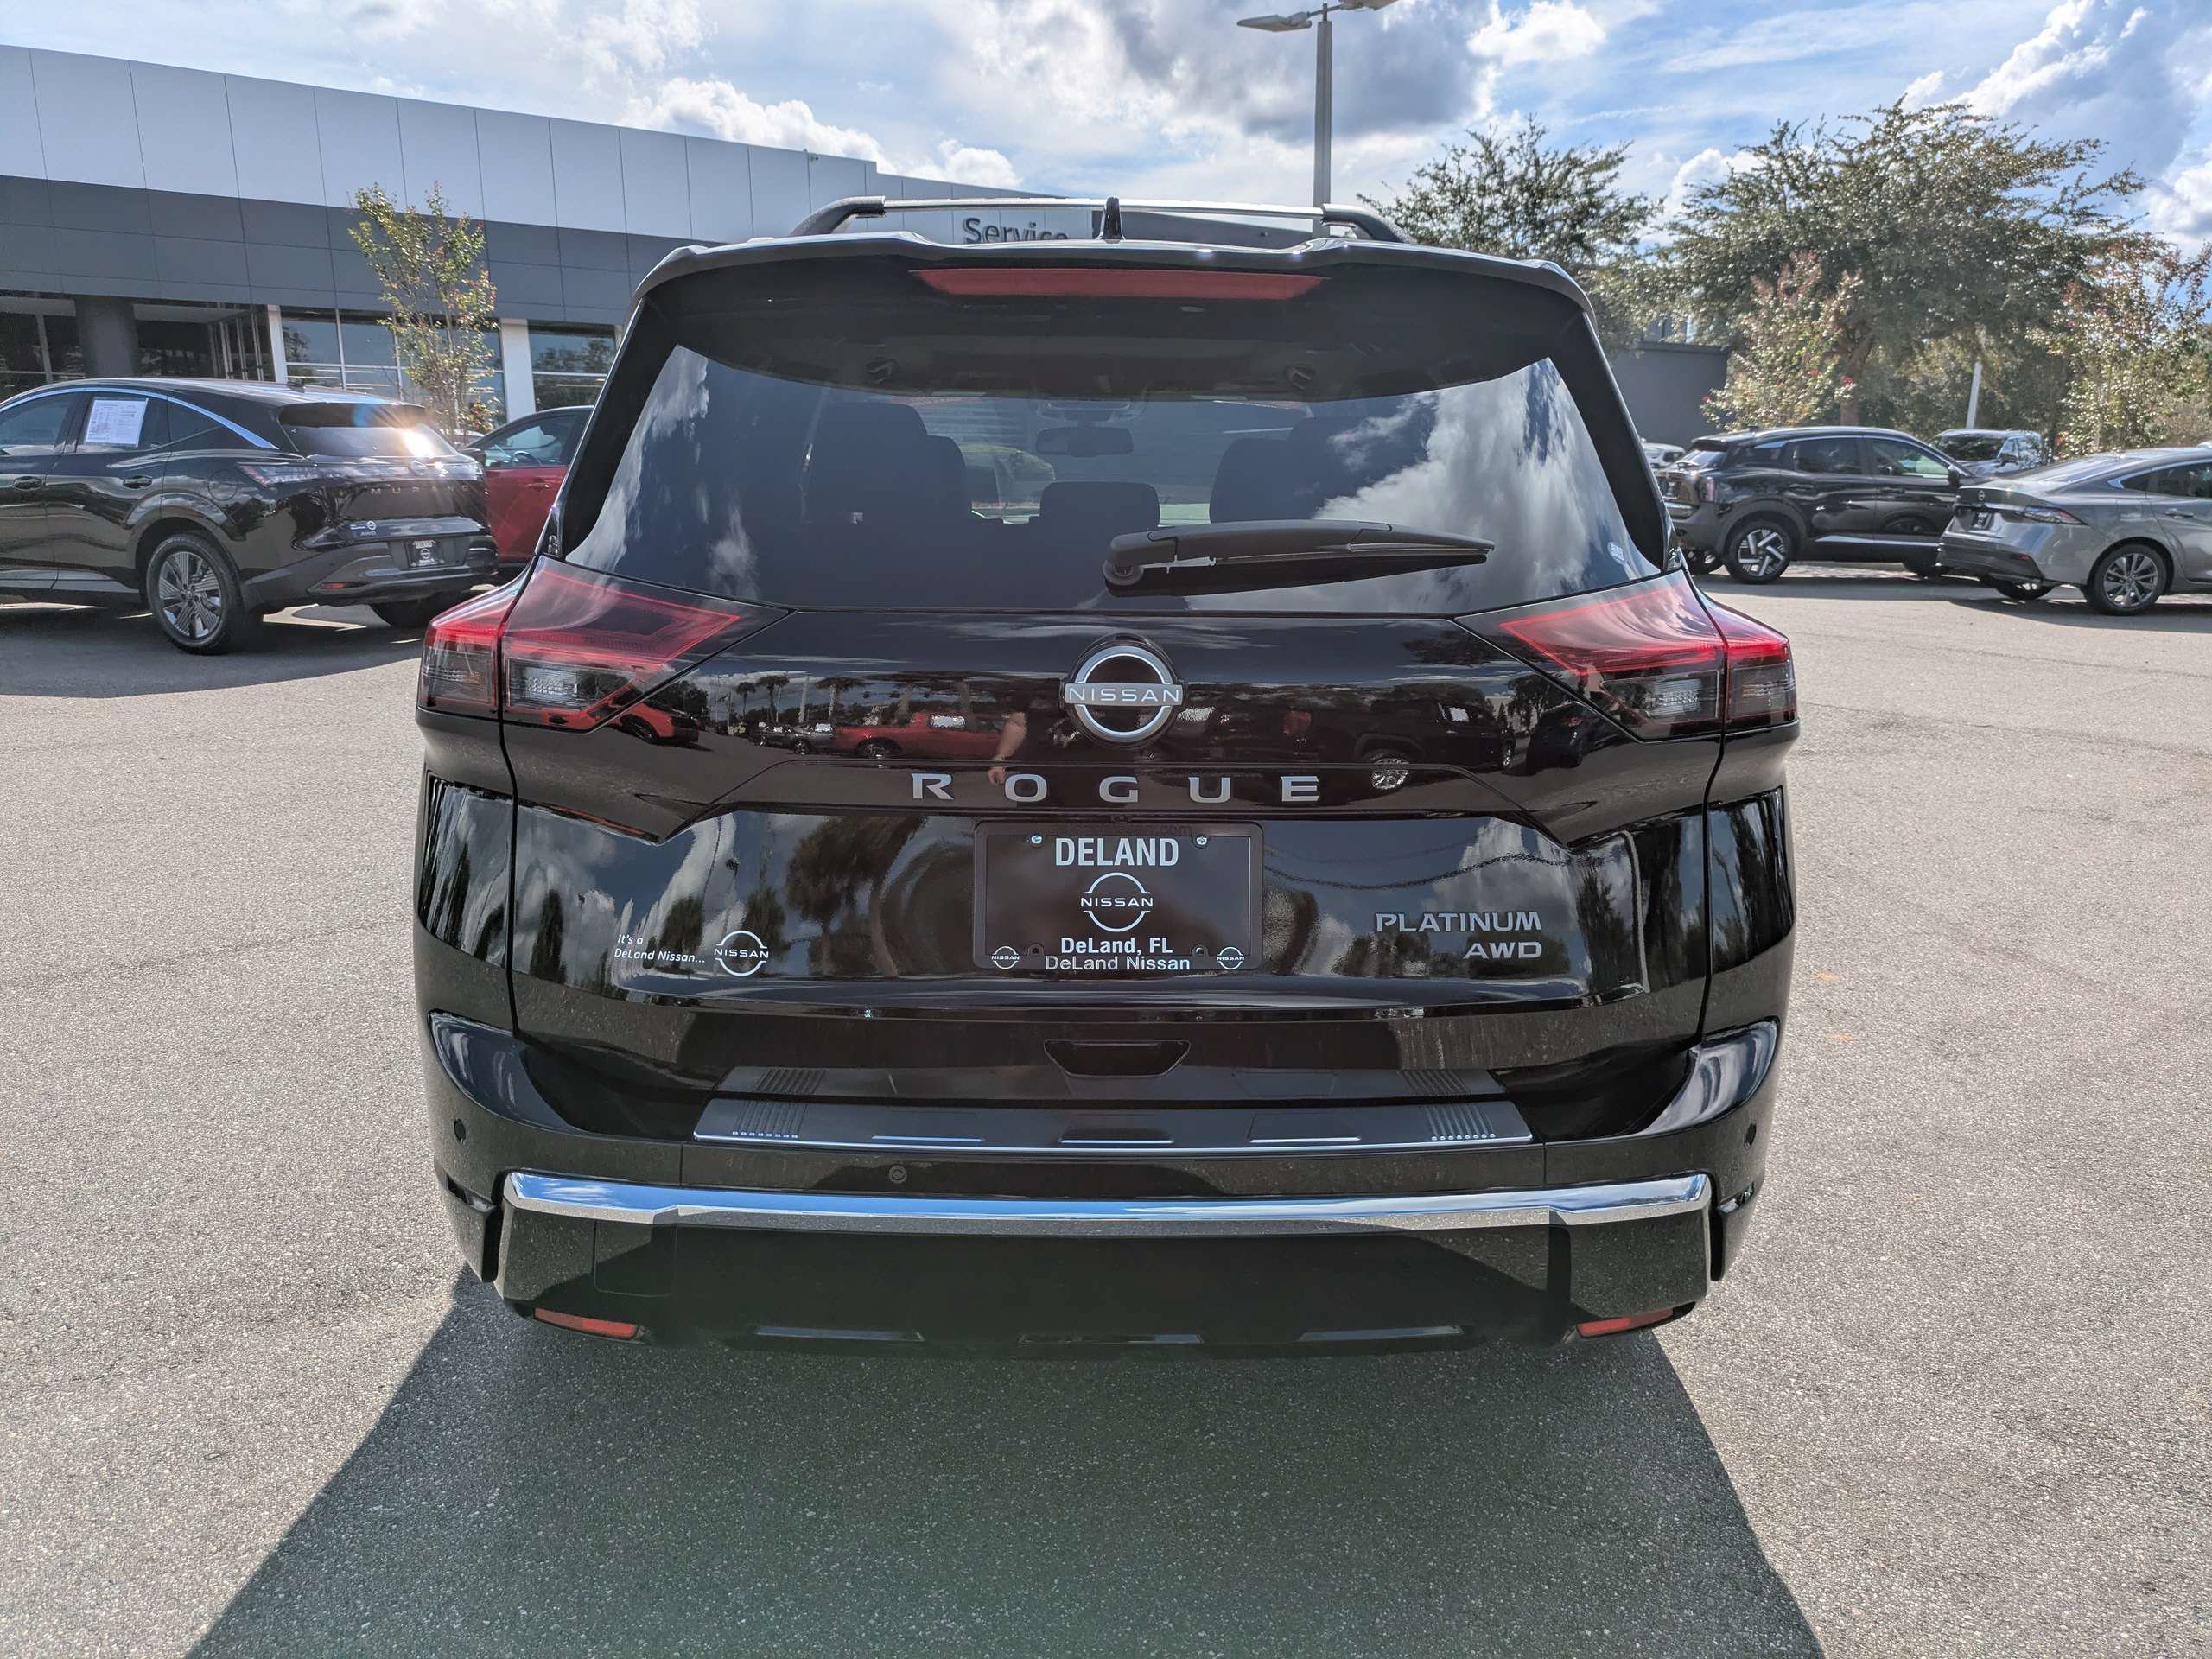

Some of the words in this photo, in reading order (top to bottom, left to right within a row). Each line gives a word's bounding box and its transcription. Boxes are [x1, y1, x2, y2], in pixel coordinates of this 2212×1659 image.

[1067, 688, 1180, 702] NISSAN
[912, 772, 1320, 804] ROGUE
[1055, 838, 1179, 866] DELAND
[1081, 897, 1154, 907] NISSAN
[1376, 912, 1542, 932] PLATINUM
[617, 933, 633, 944] It's
[714, 948, 769, 958] NISSAN
[1061, 938, 1141, 955] DeLand,
[1149, 938, 1173, 953] FL
[1464, 942, 1542, 959] AWD
[614, 948, 655, 960] DeLand
[658, 951, 705, 963] Nissan...
[1045, 956, 1119, 970] DeLand
[1126, 957, 1191, 970] Nissan
